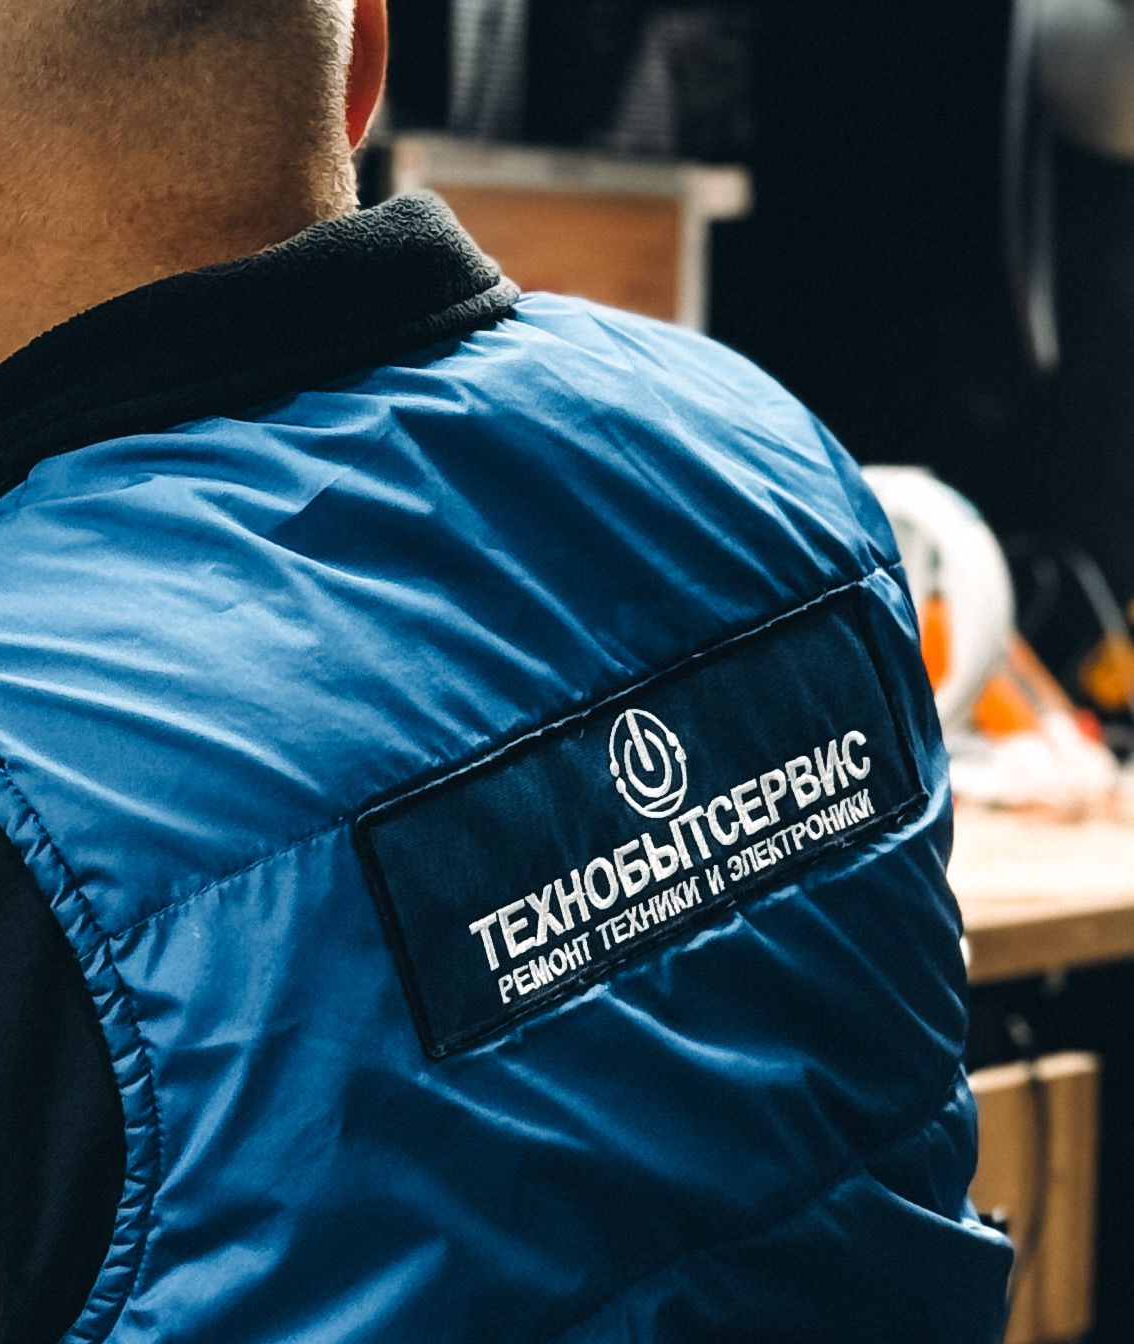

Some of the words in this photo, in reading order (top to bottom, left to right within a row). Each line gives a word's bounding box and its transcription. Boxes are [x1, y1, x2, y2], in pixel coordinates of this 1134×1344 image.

[469, 730, 871, 971] ТЕХНОБЫТСЕРВИС
[498, 932, 593, 1003] РЕМОНТ
[596, 876, 702, 951] ТЕХНИКИ
[707, 865, 725, 895] И
[729, 788, 876, 882] ЭЛЕКТРОНИКИ
